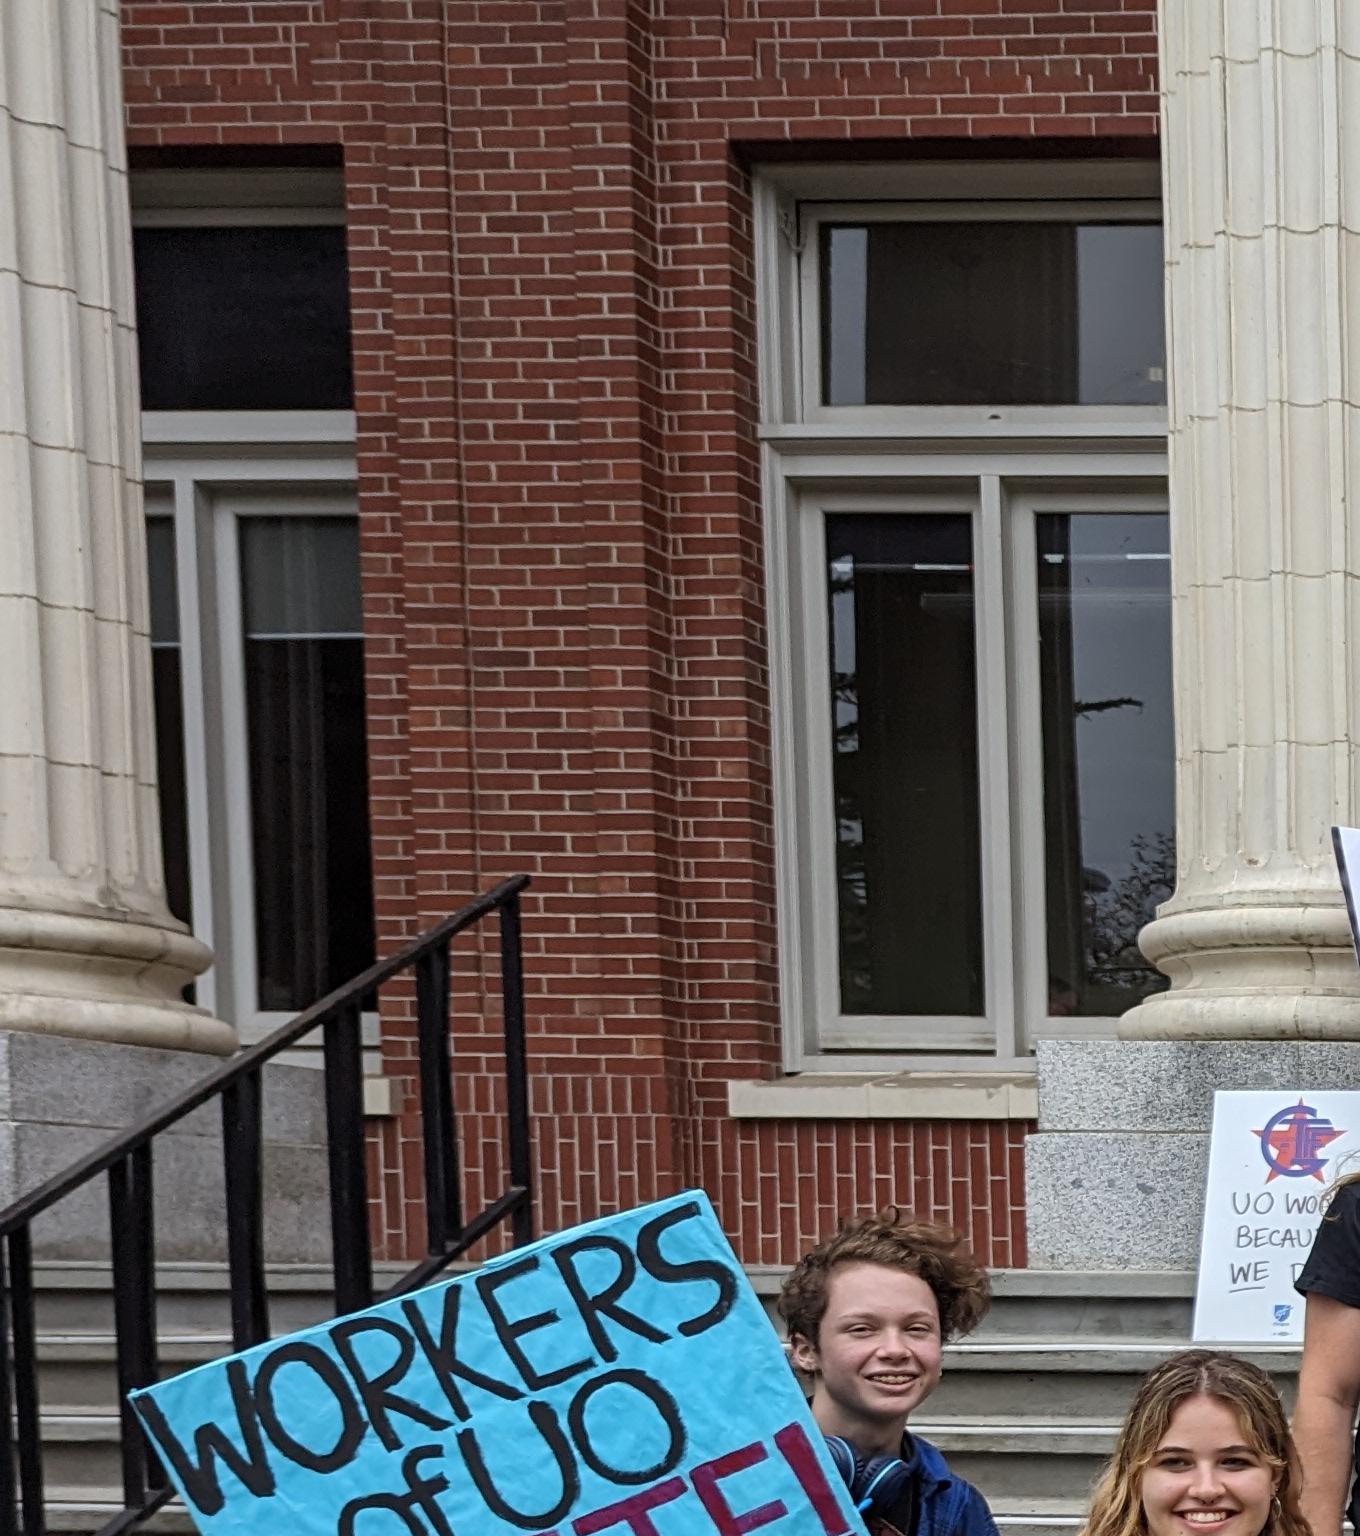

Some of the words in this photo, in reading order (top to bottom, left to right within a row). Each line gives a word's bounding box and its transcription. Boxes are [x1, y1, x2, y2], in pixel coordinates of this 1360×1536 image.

[1232, 1191, 1275, 1215] UO
[1230, 1260, 1270, 1285] WE
[134, 1203, 738, 1516] WORKERS
[458, 1369, 688, 1530] UO
